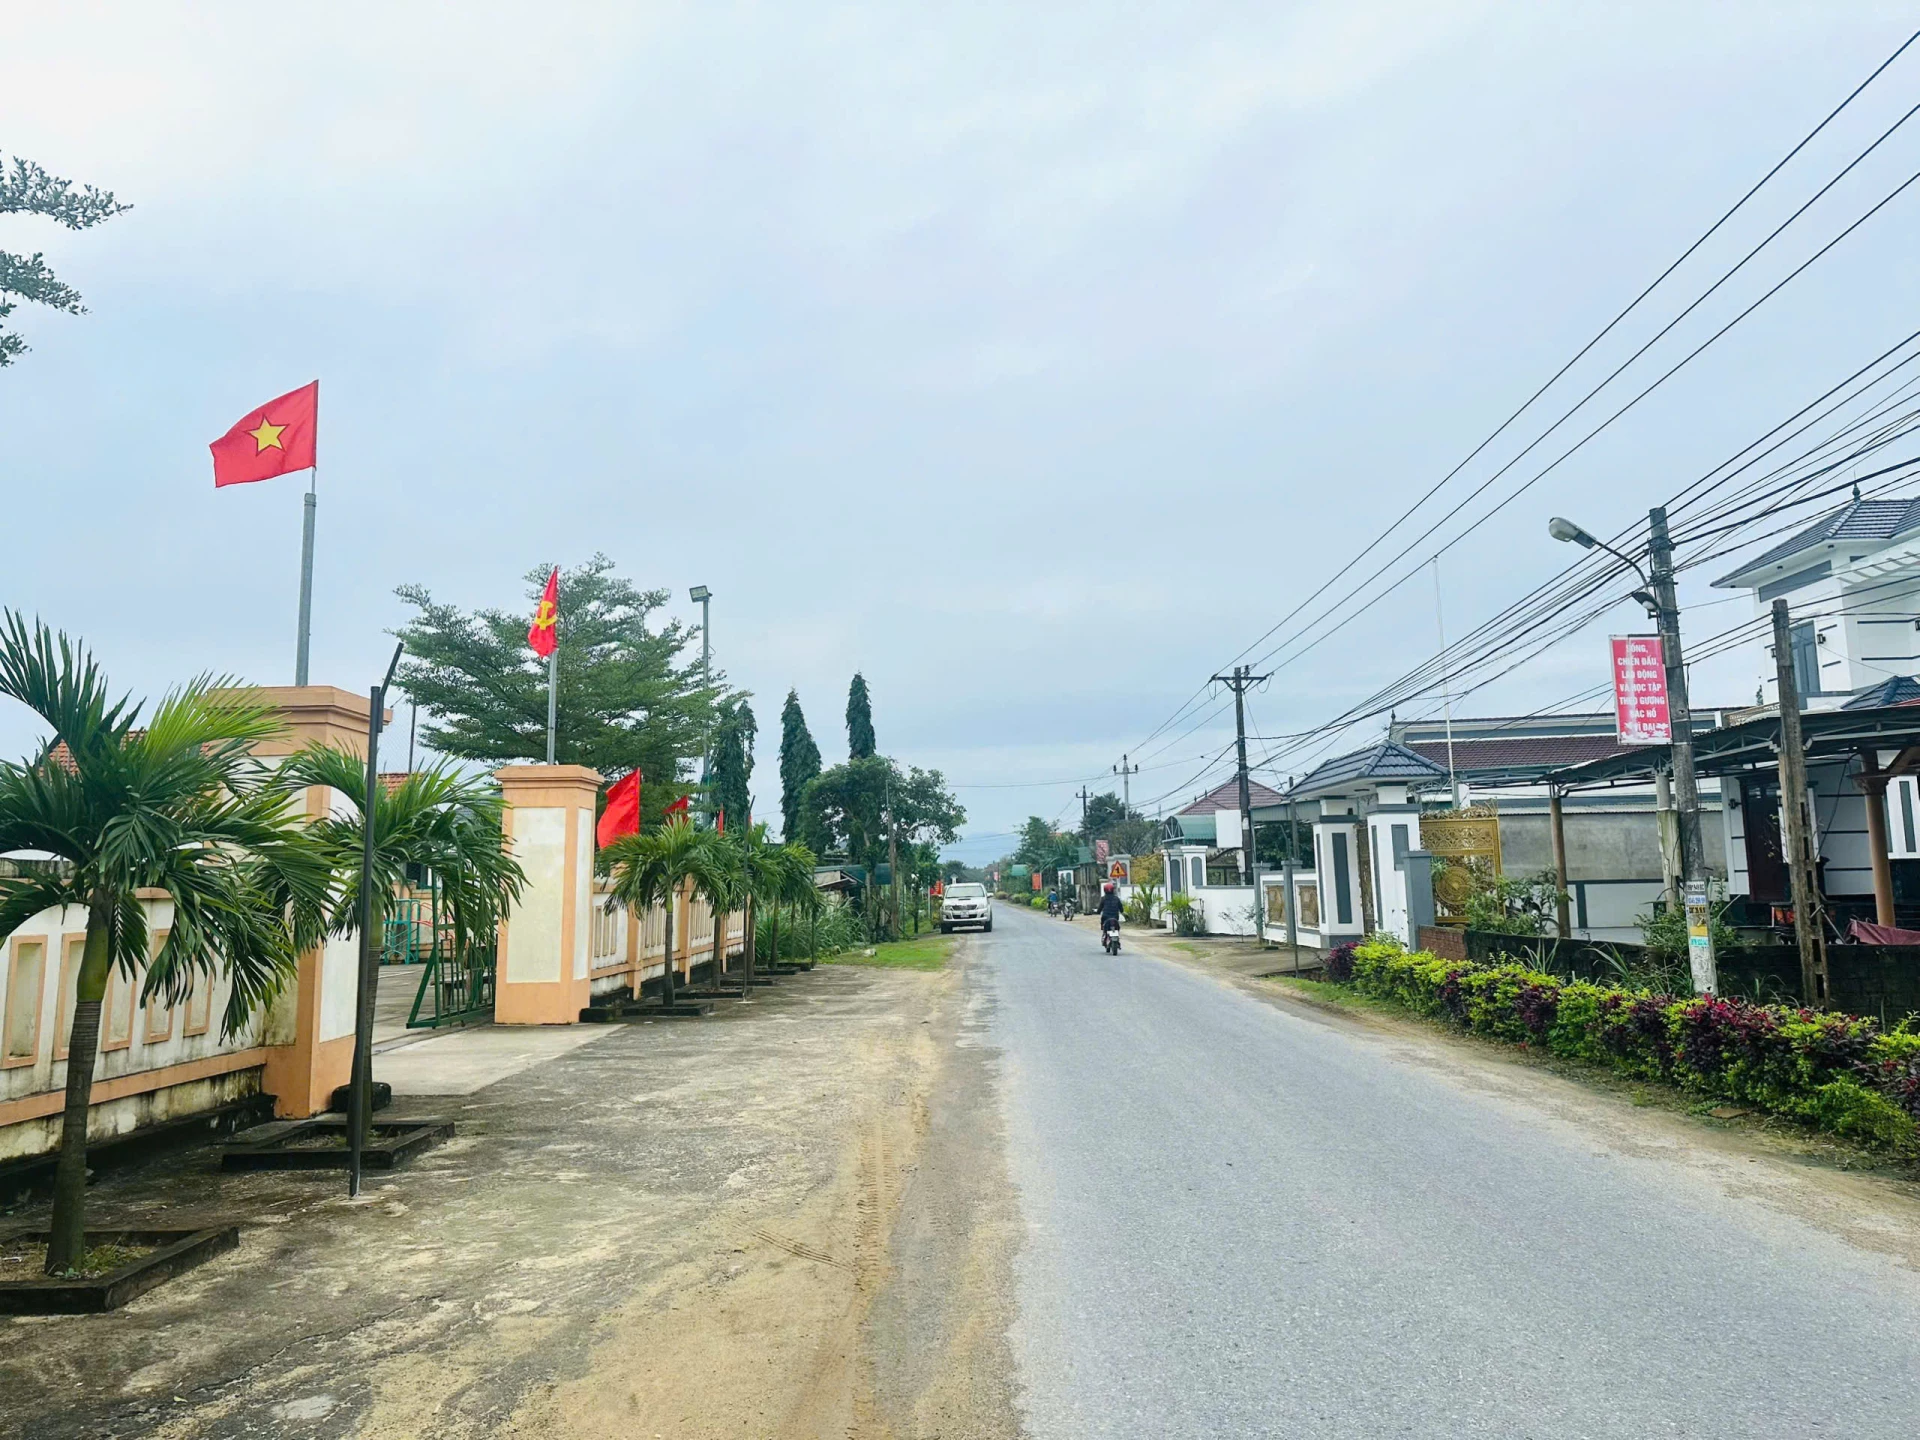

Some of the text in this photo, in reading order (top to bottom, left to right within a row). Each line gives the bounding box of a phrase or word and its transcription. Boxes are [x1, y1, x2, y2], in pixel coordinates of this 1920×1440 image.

[1621, 669, 1657, 680] LO ĐỘNG
[1648, 682, 1662, 693] TẬP
[1618, 696, 1638, 705] THO
